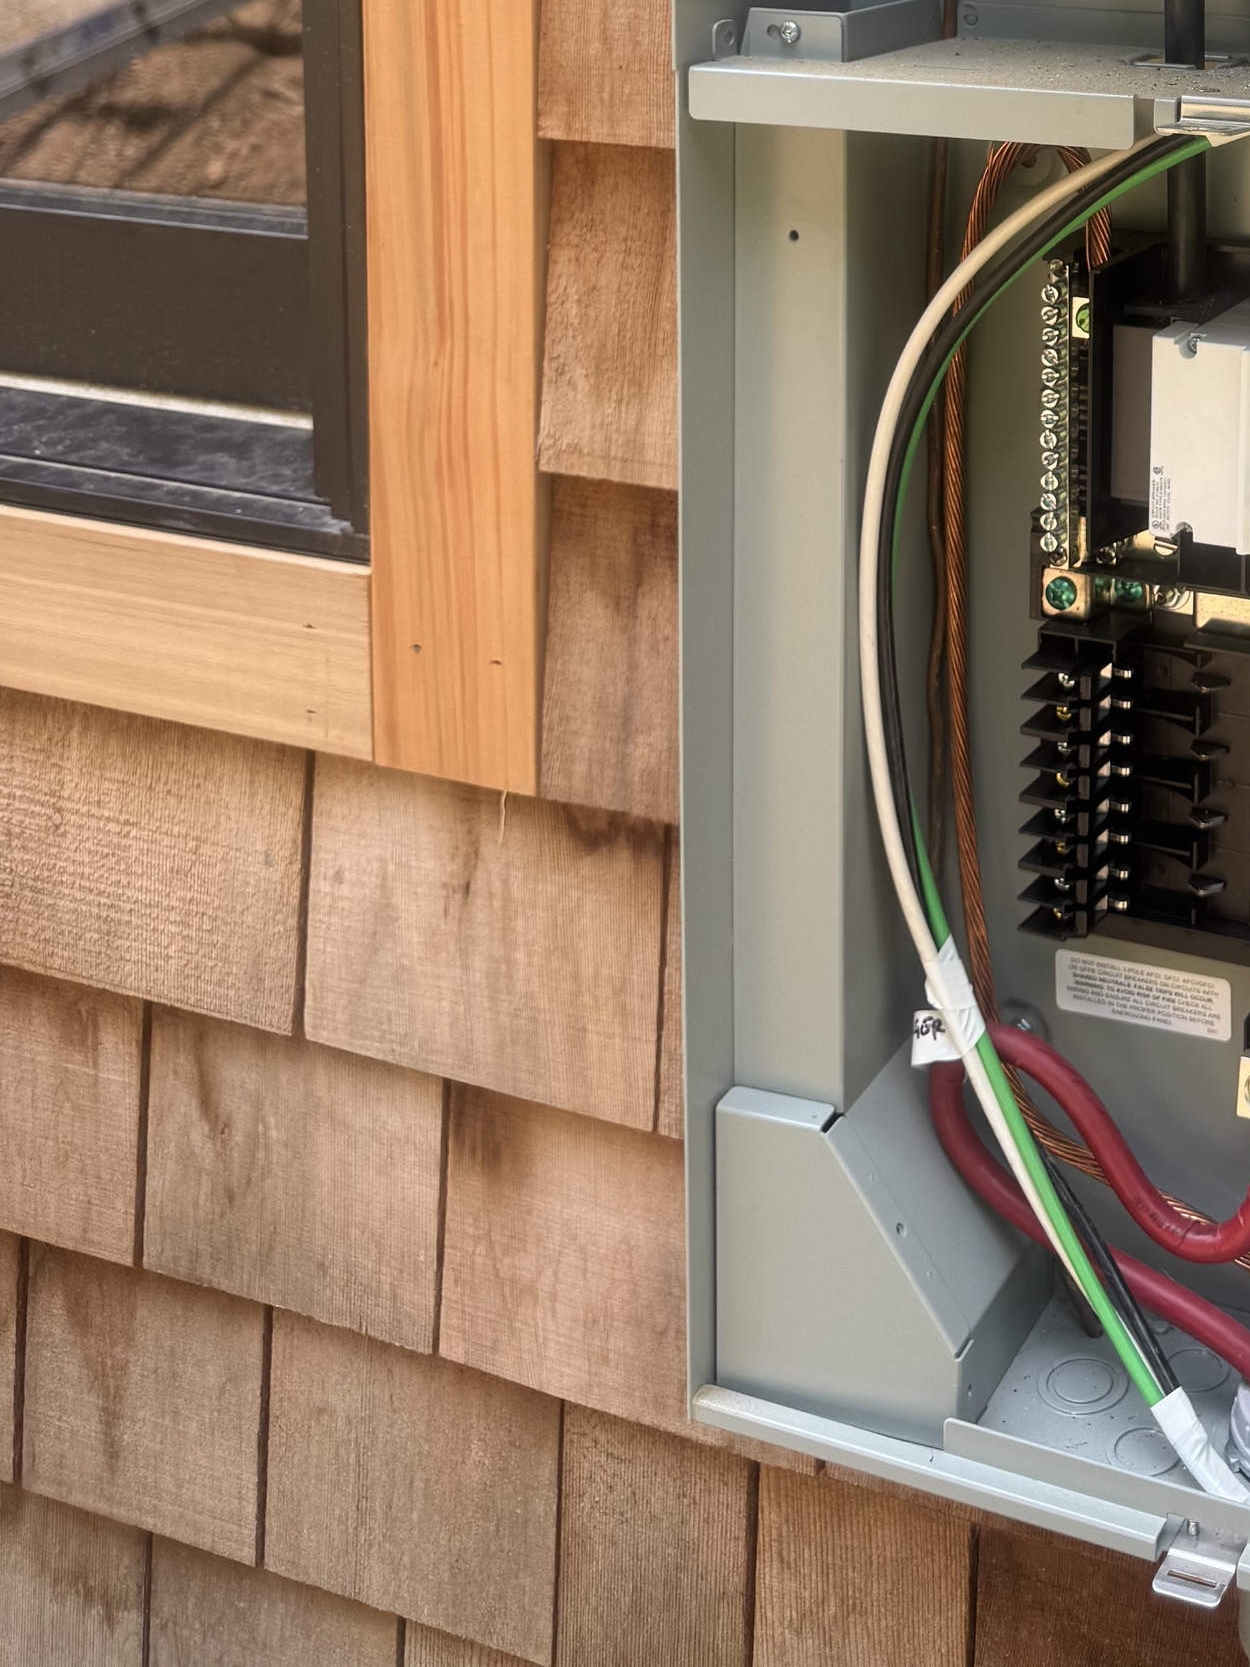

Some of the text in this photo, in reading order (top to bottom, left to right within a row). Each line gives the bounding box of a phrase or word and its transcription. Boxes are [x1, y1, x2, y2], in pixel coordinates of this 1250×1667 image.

[1097, 969, 1122, 979] CIRCUIT
[1124, 973, 1159, 986] BREAKERS
[1170, 982, 1201, 993] CIRCUITS
[1202, 988, 1219, 997] WITH
[1134, 983, 1154, 992] FALSE
[1174, 991, 1189, 999] WILL
[1116, 987, 1135, 996] AVOID
[1136, 991, 1151, 999] RISK
[1177, 998, 1200, 1008] CHECK
[1116, 1001, 1129, 1009] THE
[1157, 1009, 1188, 1020] POSITION
[1145, 1000, 1170, 1010] CIRCUIT
[1172, 1005, 1207, 1017] BREAKERS
[1208, 1011, 1221, 1020] ARE
